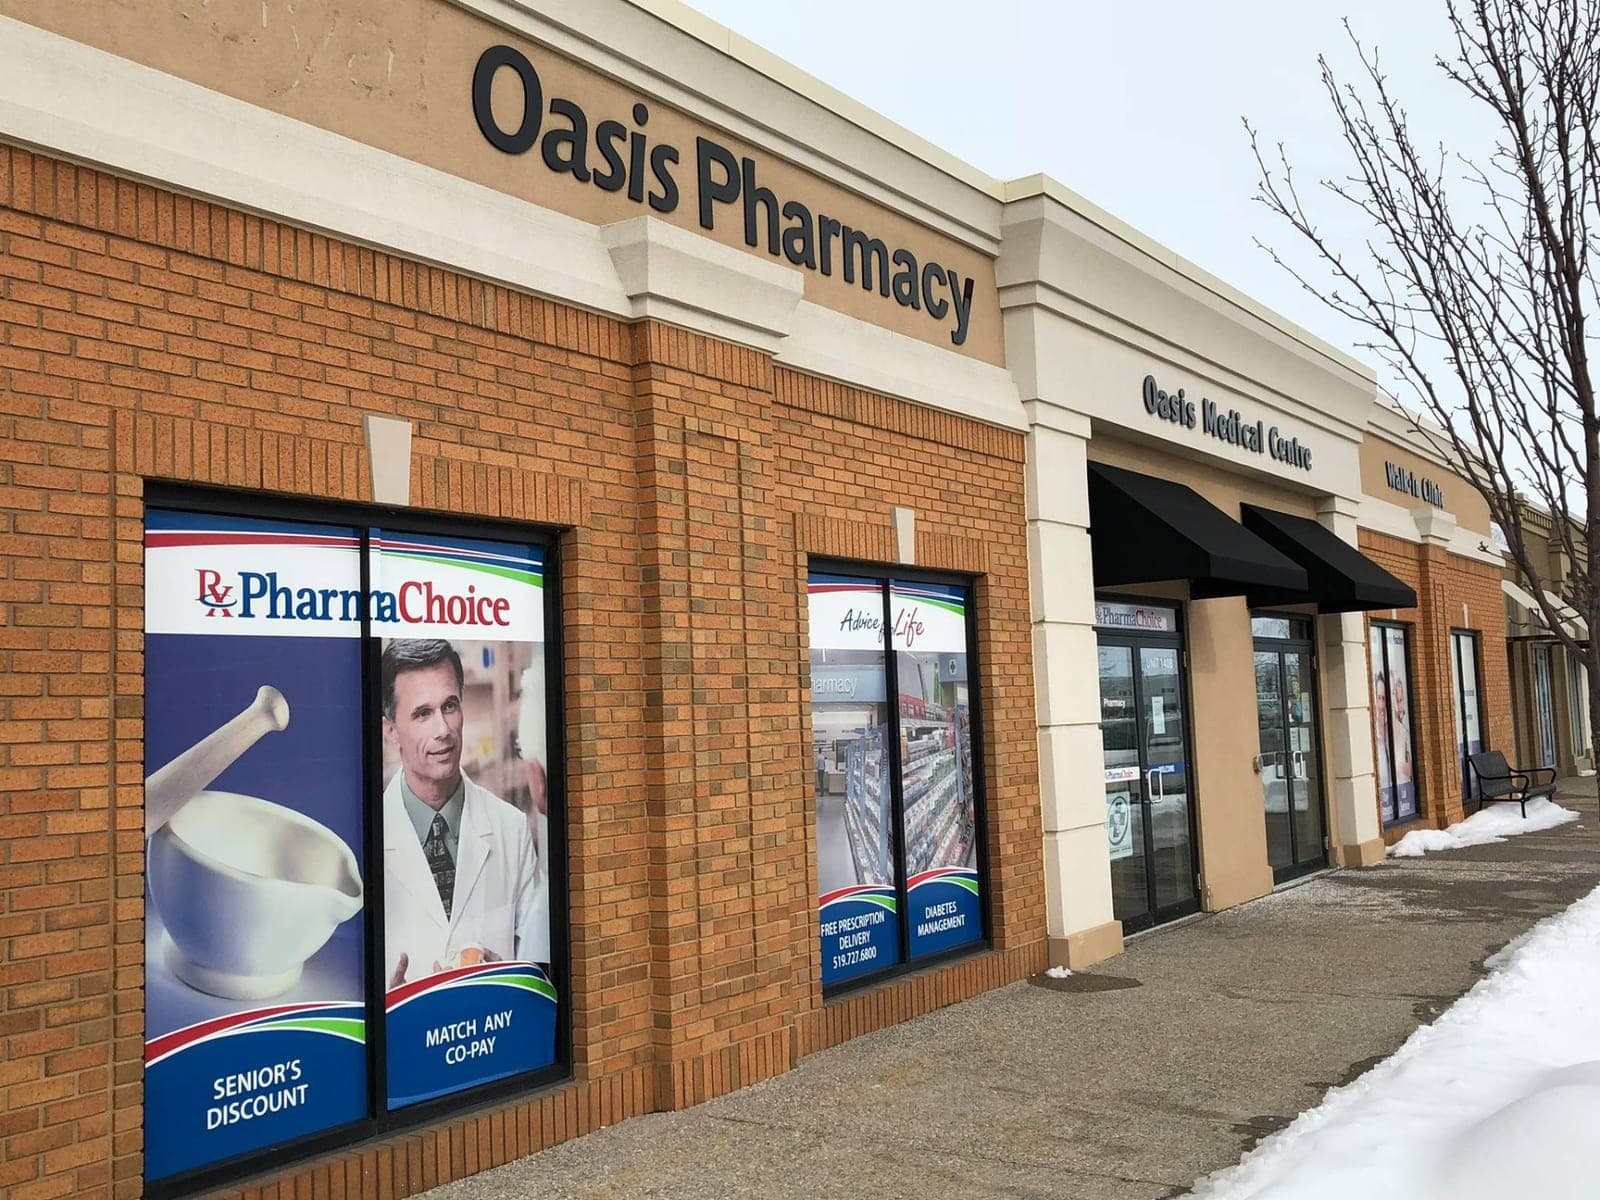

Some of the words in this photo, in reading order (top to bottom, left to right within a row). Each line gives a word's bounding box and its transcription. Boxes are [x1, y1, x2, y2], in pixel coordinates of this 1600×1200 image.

[472, 45, 680, 212] Oasis
[696, 136, 975, 345] Pharmacy
[1143, 375, 1196, 429] Oasis
[1203, 398, 1264, 454] Medical
[1269, 427, 1312, 471] Centre
[238, 571, 510, 626] PharmaChoice
[840, 608, 880, 632] Advice
[895, 607, 925, 647] Life
[1103, 607, 1162, 628] PharmaChoice
[820, 922, 838, 937] FREE
[838, 911, 885, 932] PRESCRIPTION
[917, 914, 966, 937] MANAGEMENT
[925, 901, 957, 920] DIABETES
[839, 930, 871, 950] DELIVERY
[833, 946, 877, 969] 519.727.6800
[425, 1024, 477, 1048] MATCH
[484, 1010, 513, 1032] ANY
[445, 1036, 497, 1066] CO-PAY
[213, 1059, 302, 1100] SENIOR'S
[206, 1083, 309, 1131] DISCOUNT
